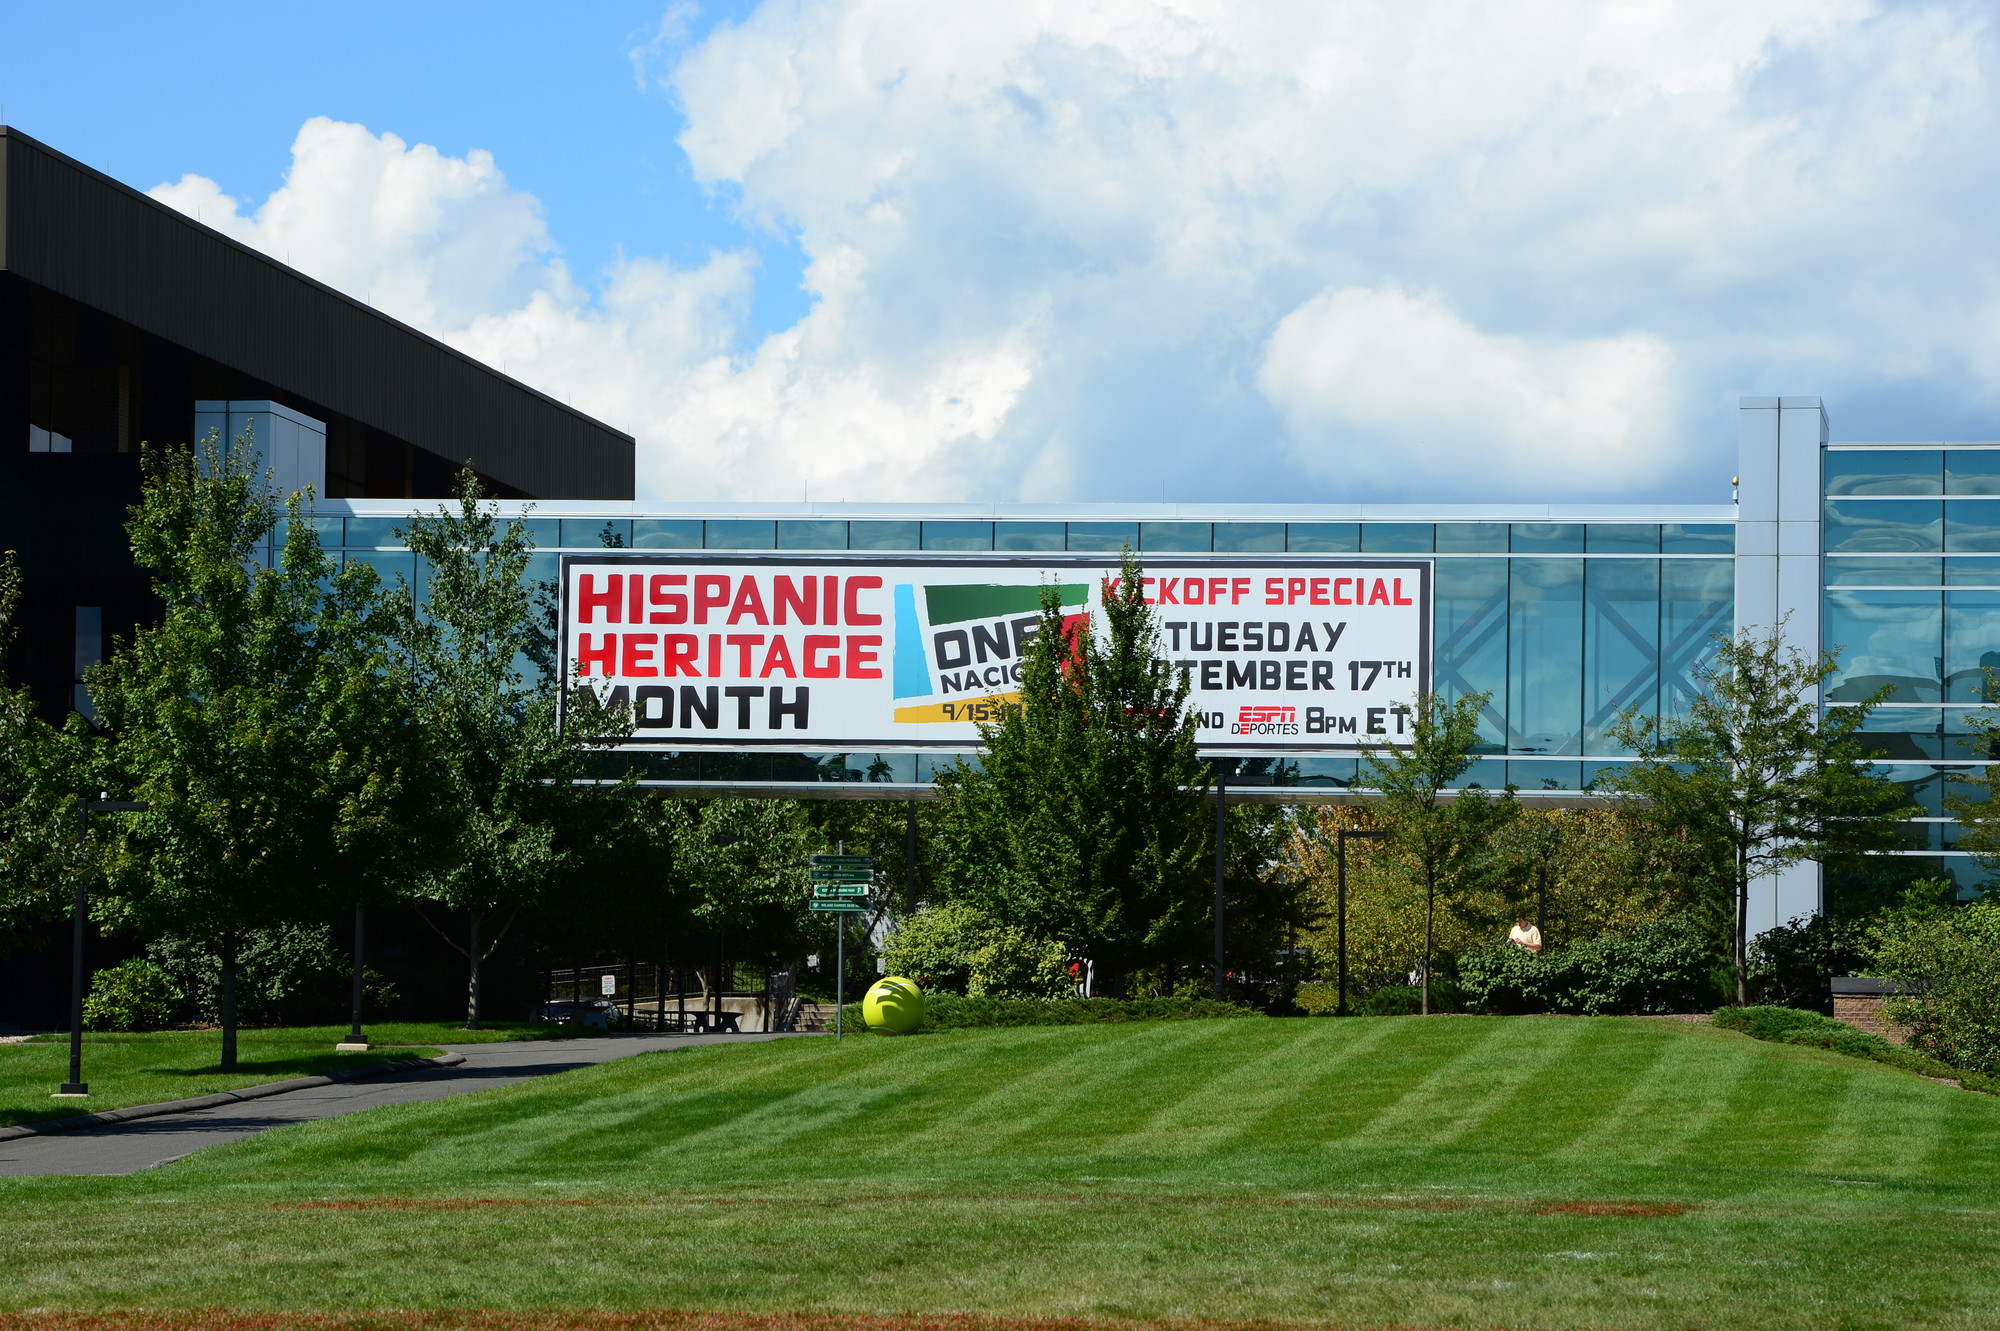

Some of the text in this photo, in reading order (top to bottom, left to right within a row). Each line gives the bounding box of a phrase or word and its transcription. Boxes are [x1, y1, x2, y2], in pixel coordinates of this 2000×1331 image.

[578, 573, 883, 626] HISPANIC
[1102, 577, 1413, 606] KCKOFF SPECIAL
[1164, 621, 1347, 652] TUESDAY
[578, 633, 883, 679] HERITAGE
[940, 658, 1023, 694] NACIÓ
[1347, 660, 1412, 691] 17TH
[578, 685, 810, 730] MONTH
[1238, 706, 1296, 722] ESPN
[1366, 707, 1411, 735] ET
[1231, 722, 1299, 735] DEPORTES
